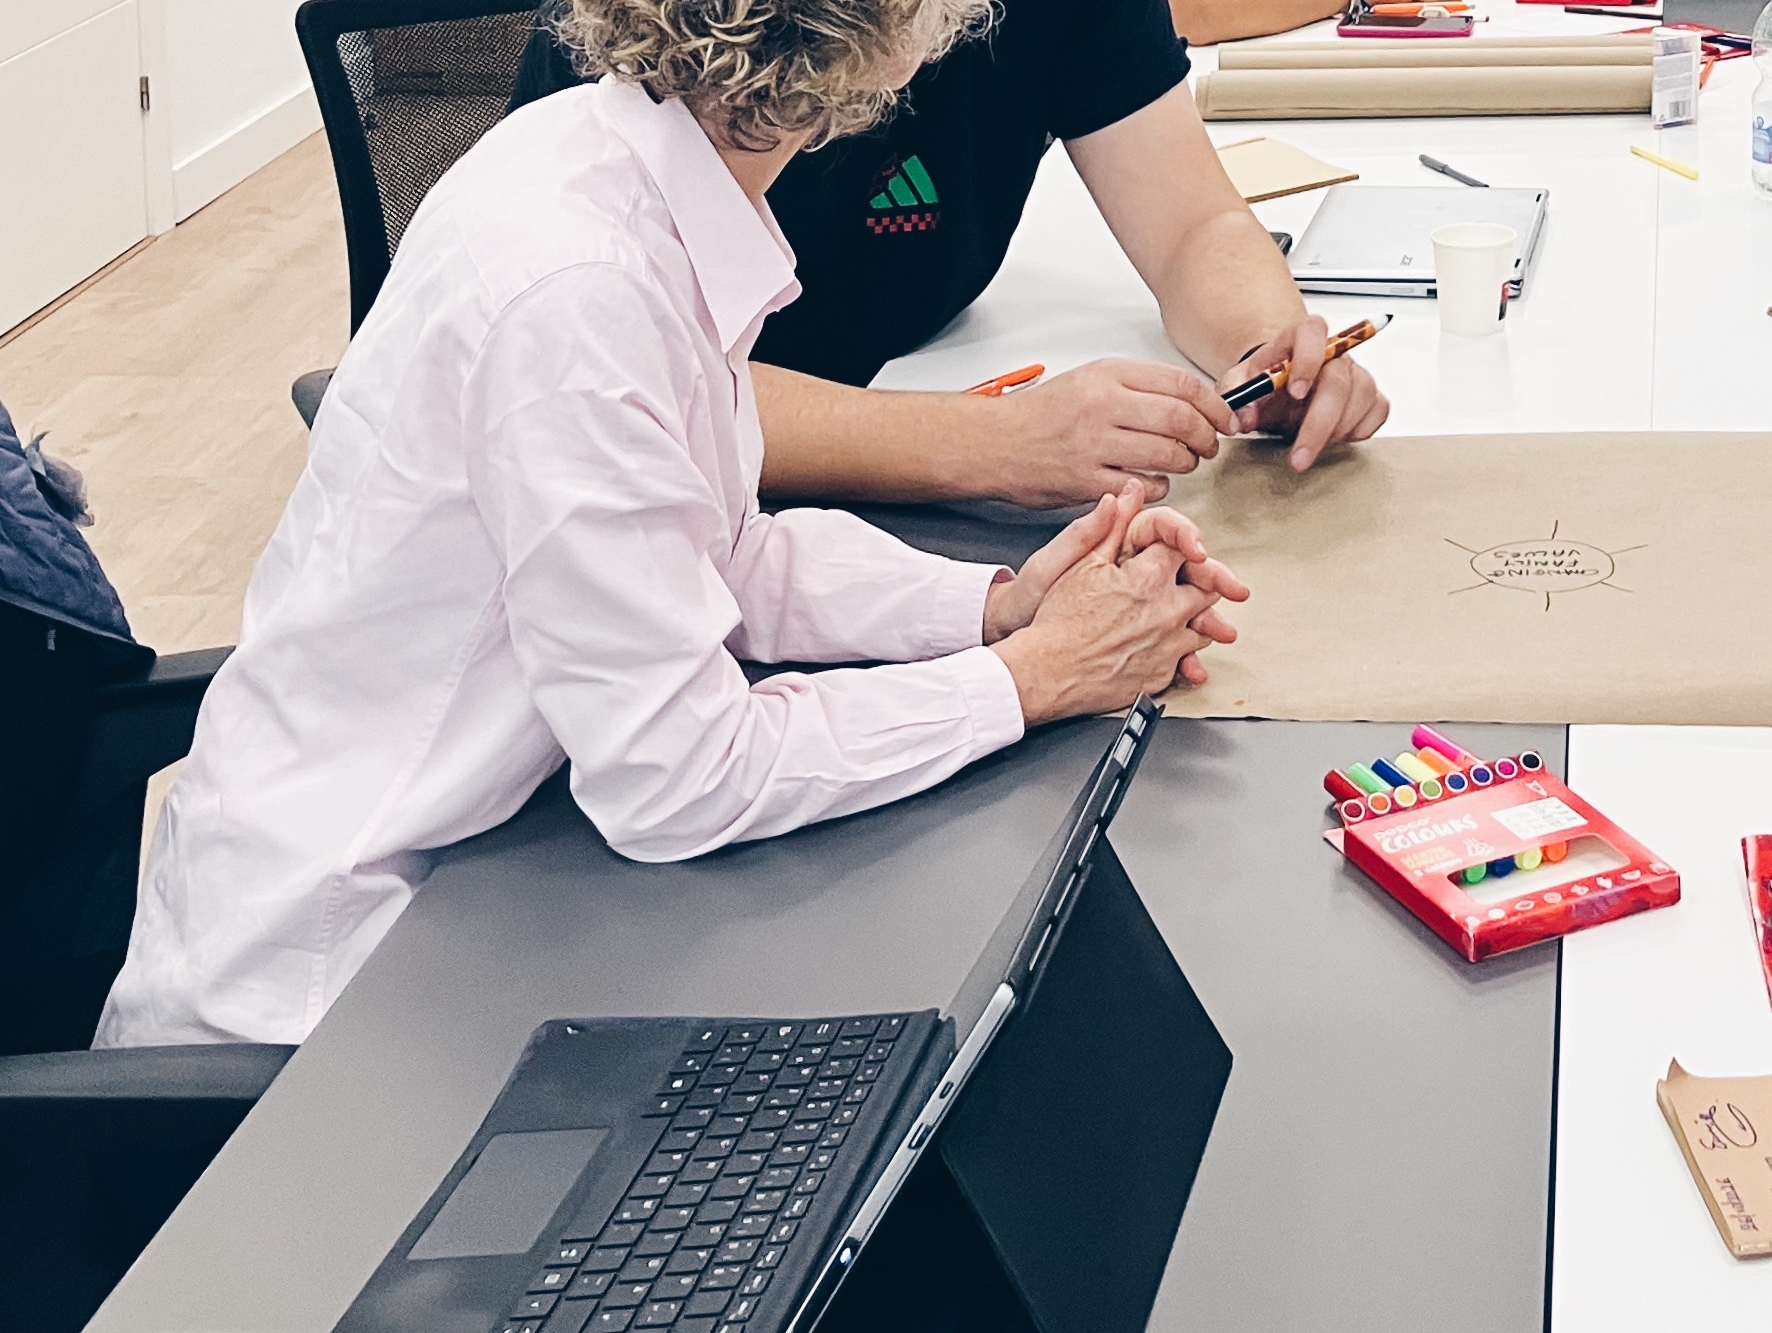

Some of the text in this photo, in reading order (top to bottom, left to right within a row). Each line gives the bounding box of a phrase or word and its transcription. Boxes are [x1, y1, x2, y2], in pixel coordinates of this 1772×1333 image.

[1493, 549, 1581, 559] VALUES
[1504, 559, 1579, 568] FAMILY
[1381, 813, 1479, 854] COLOURS
